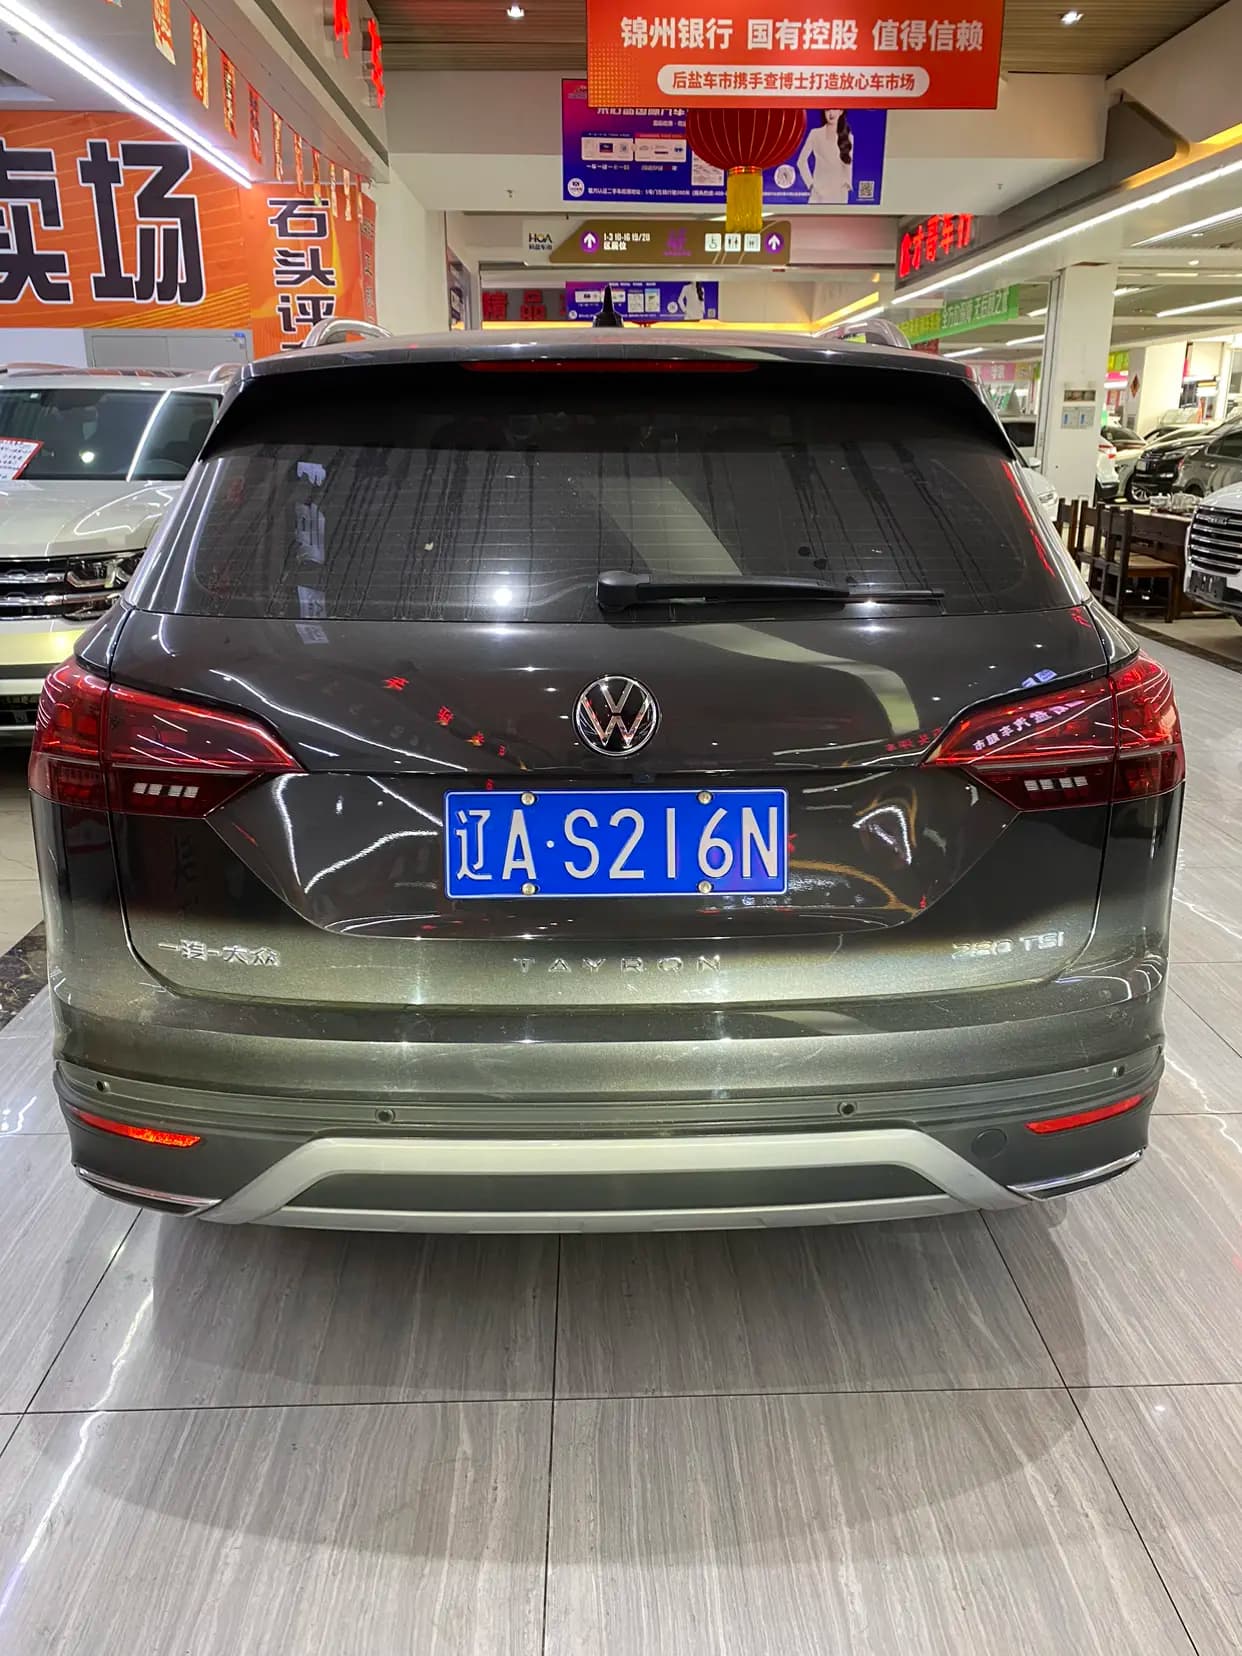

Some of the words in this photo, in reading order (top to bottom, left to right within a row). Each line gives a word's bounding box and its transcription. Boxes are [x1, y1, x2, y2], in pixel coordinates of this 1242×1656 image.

[620, 17, 734, 50] 锦州银行
[747, 18, 859, 51] 国有控股
[871, 19, 985, 52] 值得信赖
[672, 70, 916, 92] 后盐车市携手查博士打造放心车市场
[267, 197, 336, 352] 石头评
[512, 954, 722, 976] TAYRON
